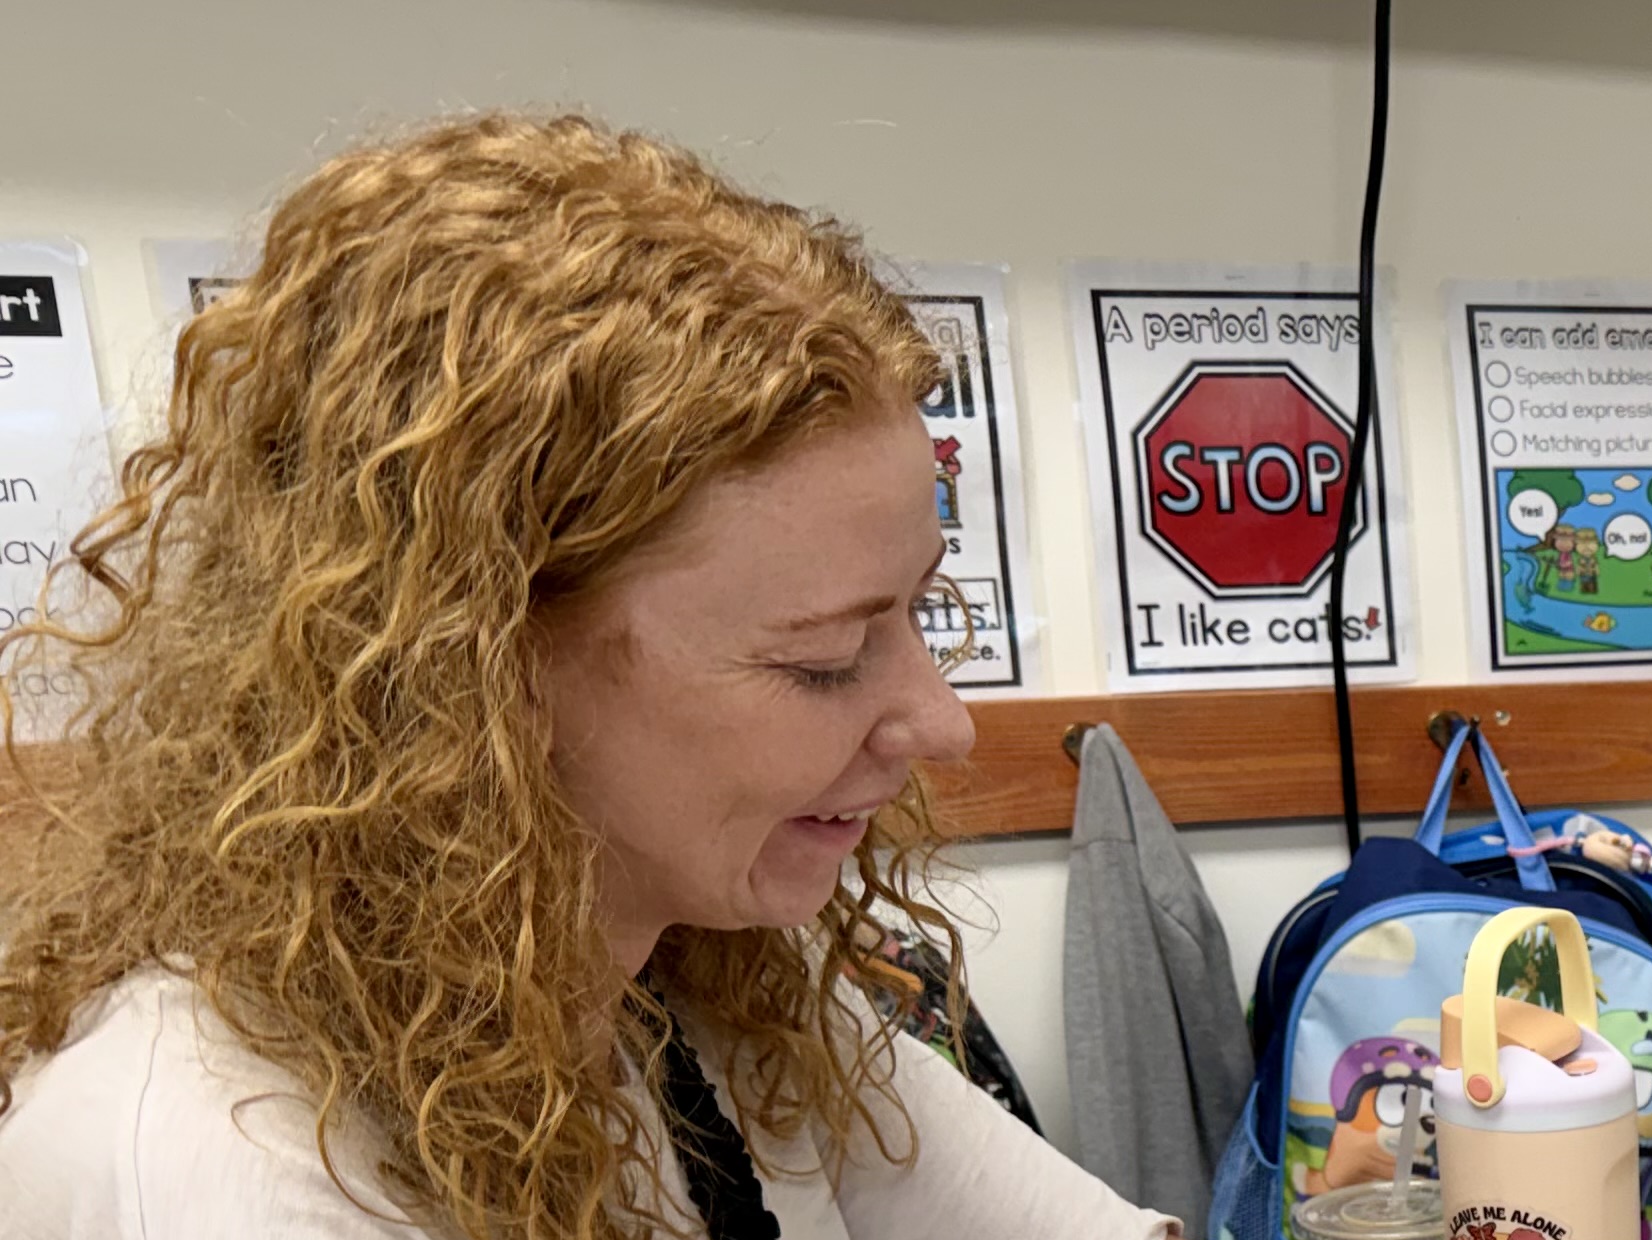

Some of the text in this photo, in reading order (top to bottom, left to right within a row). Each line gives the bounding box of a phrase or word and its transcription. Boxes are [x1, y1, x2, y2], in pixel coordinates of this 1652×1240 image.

[1104, 304, 1360, 352] A period says
[1478, 321, 1495, 349] I
[1500, 326, 1546, 350] can
[1552, 321, 1599, 350] add
[1514, 366, 1584, 389] Speech
[1519, 400, 1567, 419] Facial
[1522, 434, 1600, 457] Matching
[1158, 440, 1344, 516] STOP
[1519, 506, 1543, 518] Yes!
[1137, 603, 1164, 647] I
[1178, 603, 1251, 647] like
[1450, 1207, 1480, 1235] LEAVE
[1483, 1206, 1507, 1221] ME
